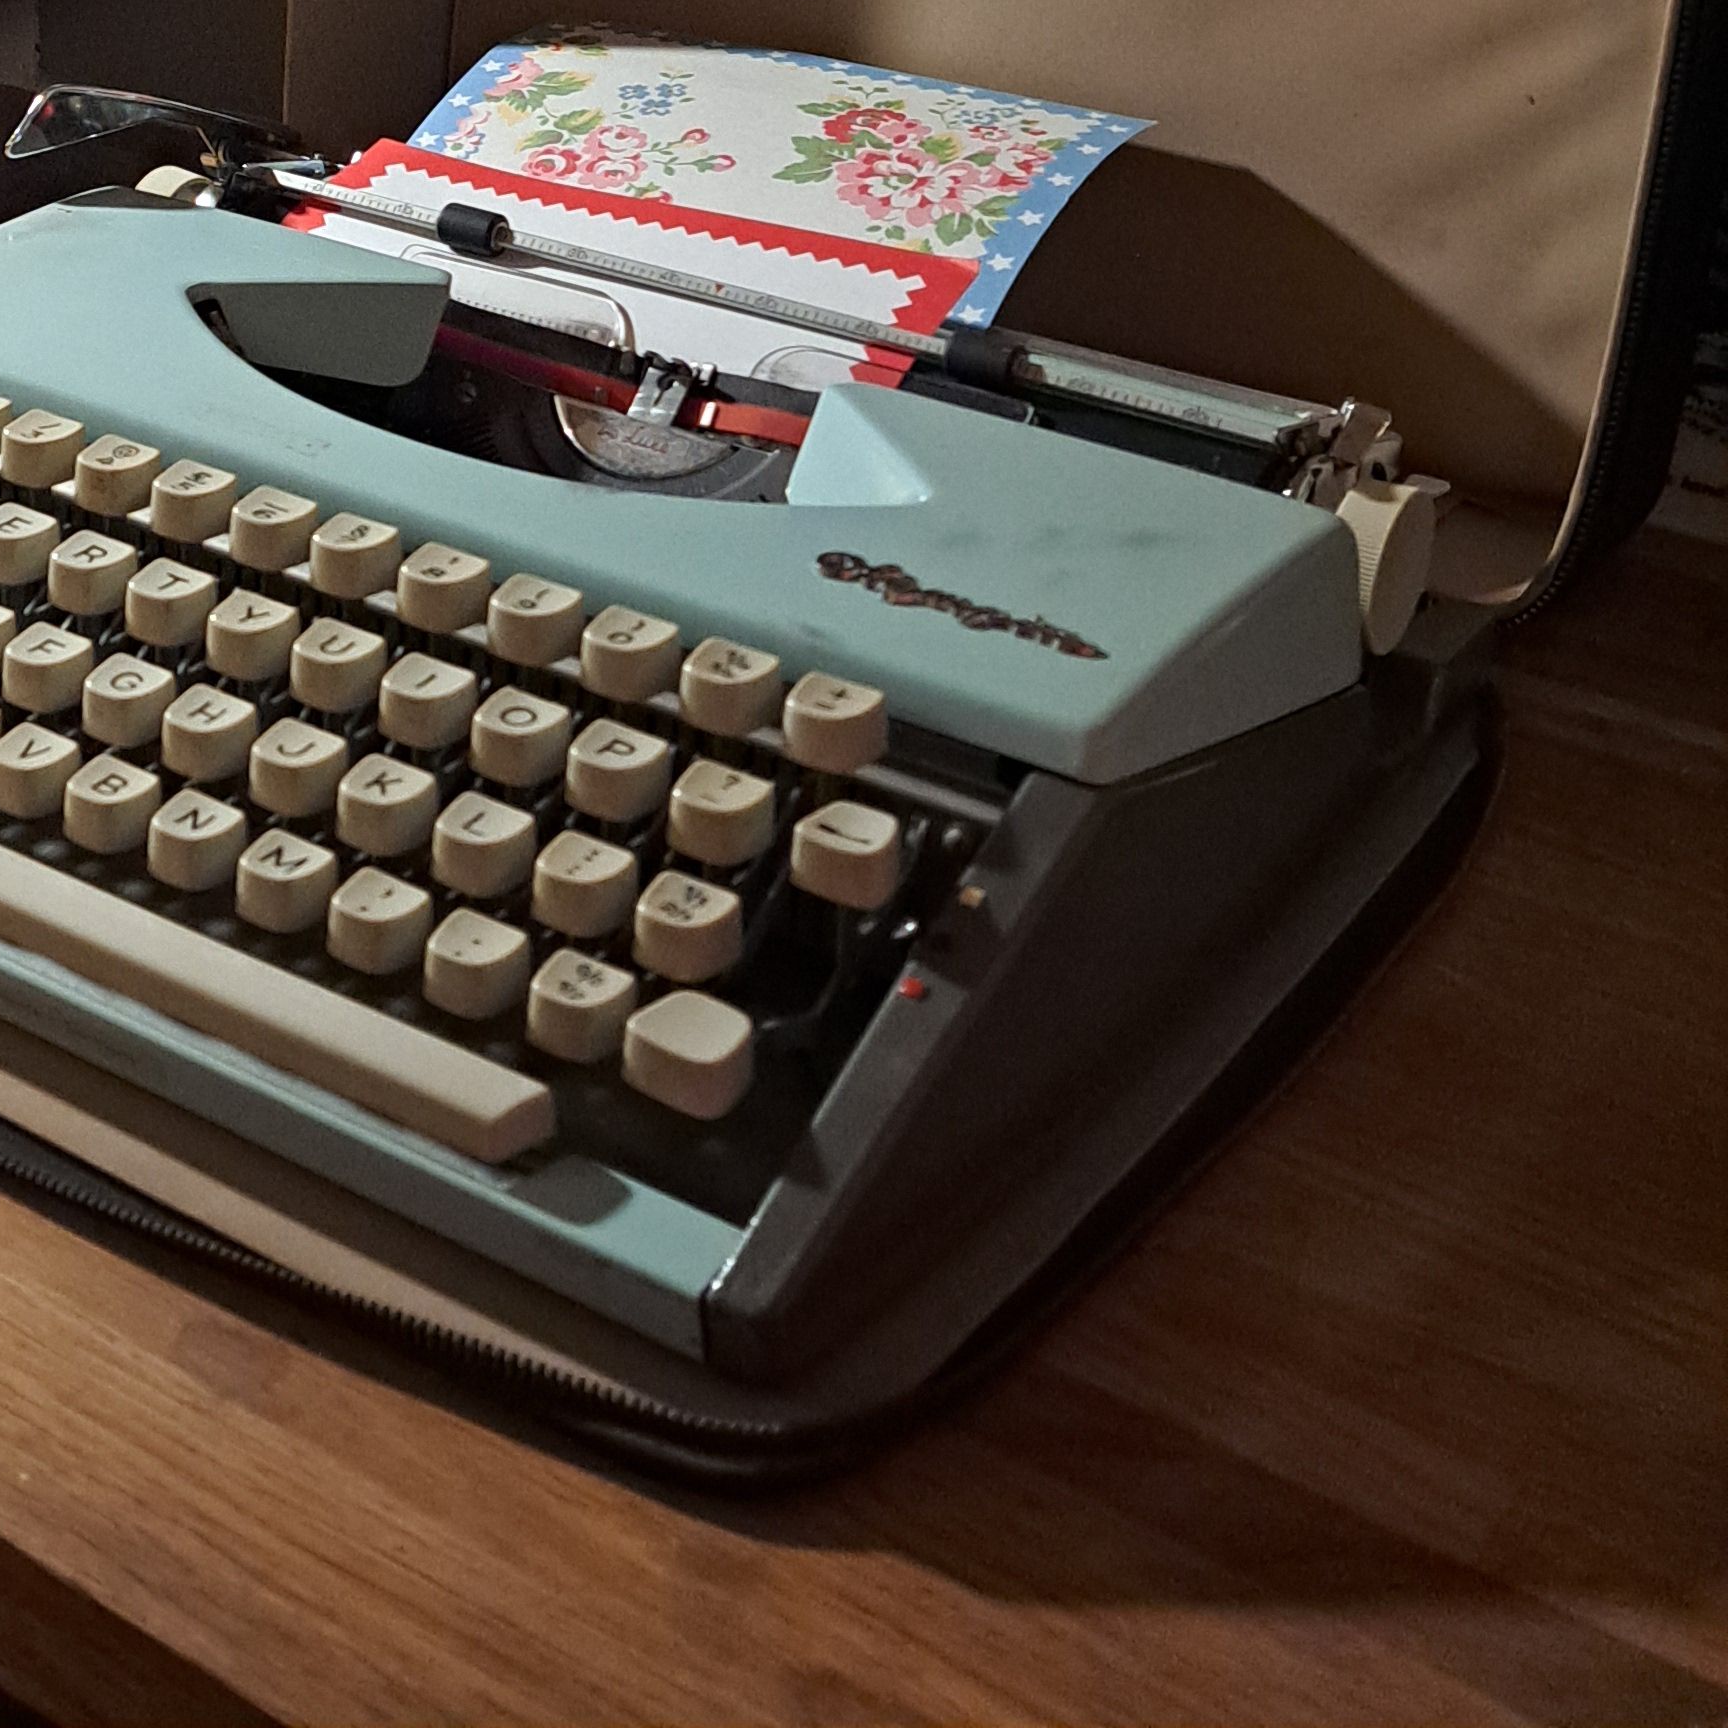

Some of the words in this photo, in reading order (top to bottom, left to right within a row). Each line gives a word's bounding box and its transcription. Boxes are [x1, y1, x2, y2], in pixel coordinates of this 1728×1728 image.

[27, 638, 66, 654] F
[110, 672, 144, 690] G
[188, 701, 228, 724] H
[277, 742, 315, 758] J
[364, 771, 403, 795] K
[462, 812, 485, 836] L
[72, 545, 108, 563] R
[158, 572, 190, 590] T
[239, 606, 271, 623] Y
[320, 634, 355, 654] U
[500, 707, 537, 727] O
[596, 739, 635, 755] P
[19, 739, 52, 758] V
[91, 773, 128, 793] B
[174, 809, 216, 830] N
[260, 845, 308, 874] M
